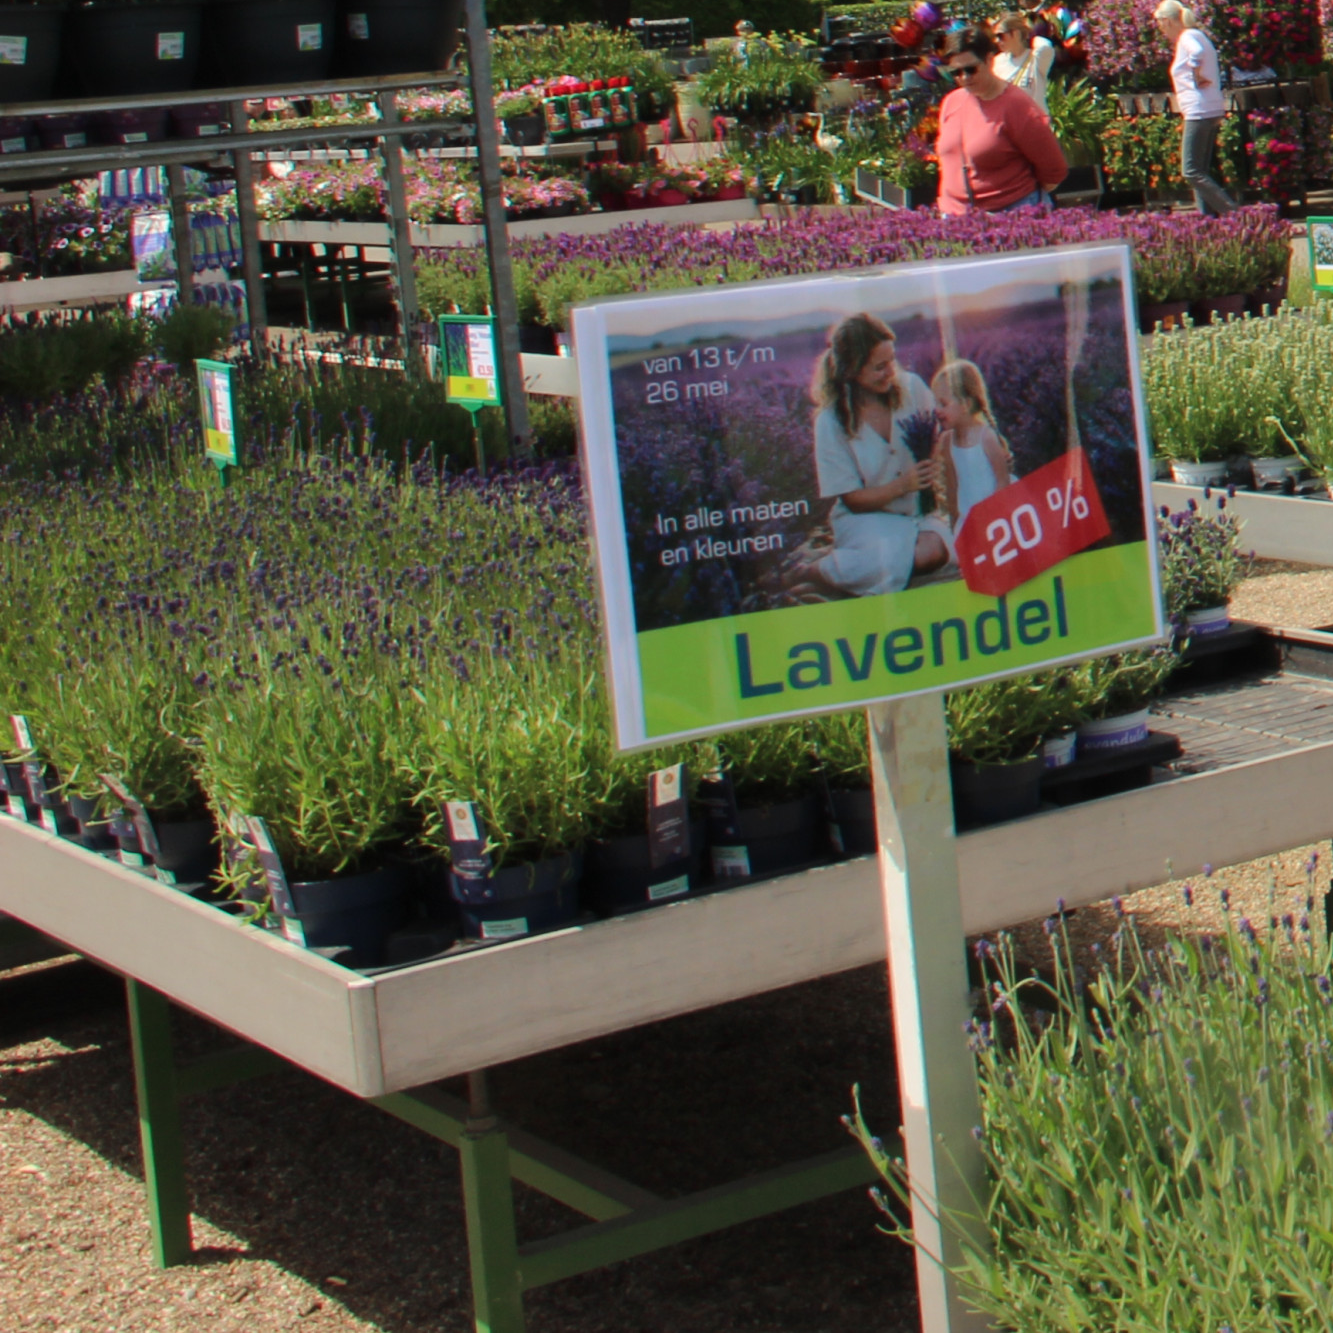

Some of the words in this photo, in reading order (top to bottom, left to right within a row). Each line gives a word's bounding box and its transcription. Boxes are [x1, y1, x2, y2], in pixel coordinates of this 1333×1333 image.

[643, 354, 682, 375] van
[688, 346, 720, 370] 13
[725, 343, 776, 371] t/m
[646, 380, 680, 405] 26
[685, 376, 730, 400] mei
[656, 513, 678, 537] In
[684, 504, 725, 532] alle
[731, 497, 810, 524] maten
[973, 502, 1040, 568] -20
[1046, 478, 1090, 529] %
[660, 545, 690, 567] en
[695, 530, 784, 562] kleuren
[734, 575, 1070, 700] Lavendel
